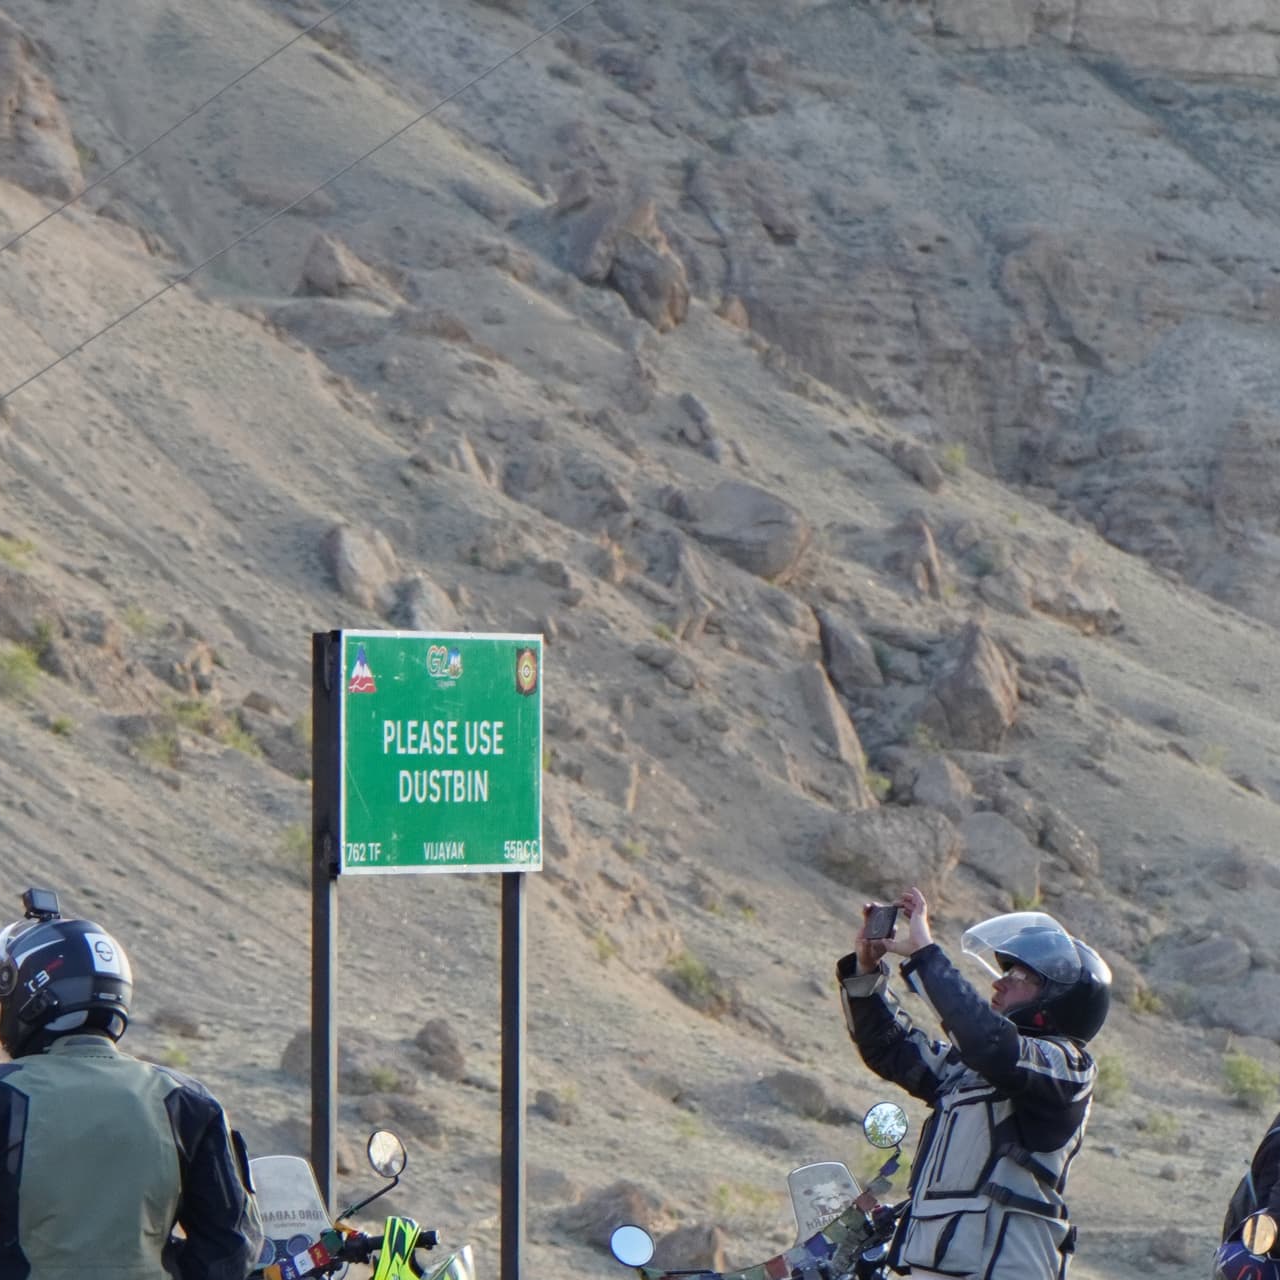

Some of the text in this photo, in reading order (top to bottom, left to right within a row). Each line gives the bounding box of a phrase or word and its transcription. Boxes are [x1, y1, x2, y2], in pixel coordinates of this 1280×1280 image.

[383, 720, 505, 755] PLEASE USE
[399, 769, 489, 803] DUSTBIN
[346, 842, 382, 862] 762 TF
[423, 841, 465, 862] VIJAYAK
